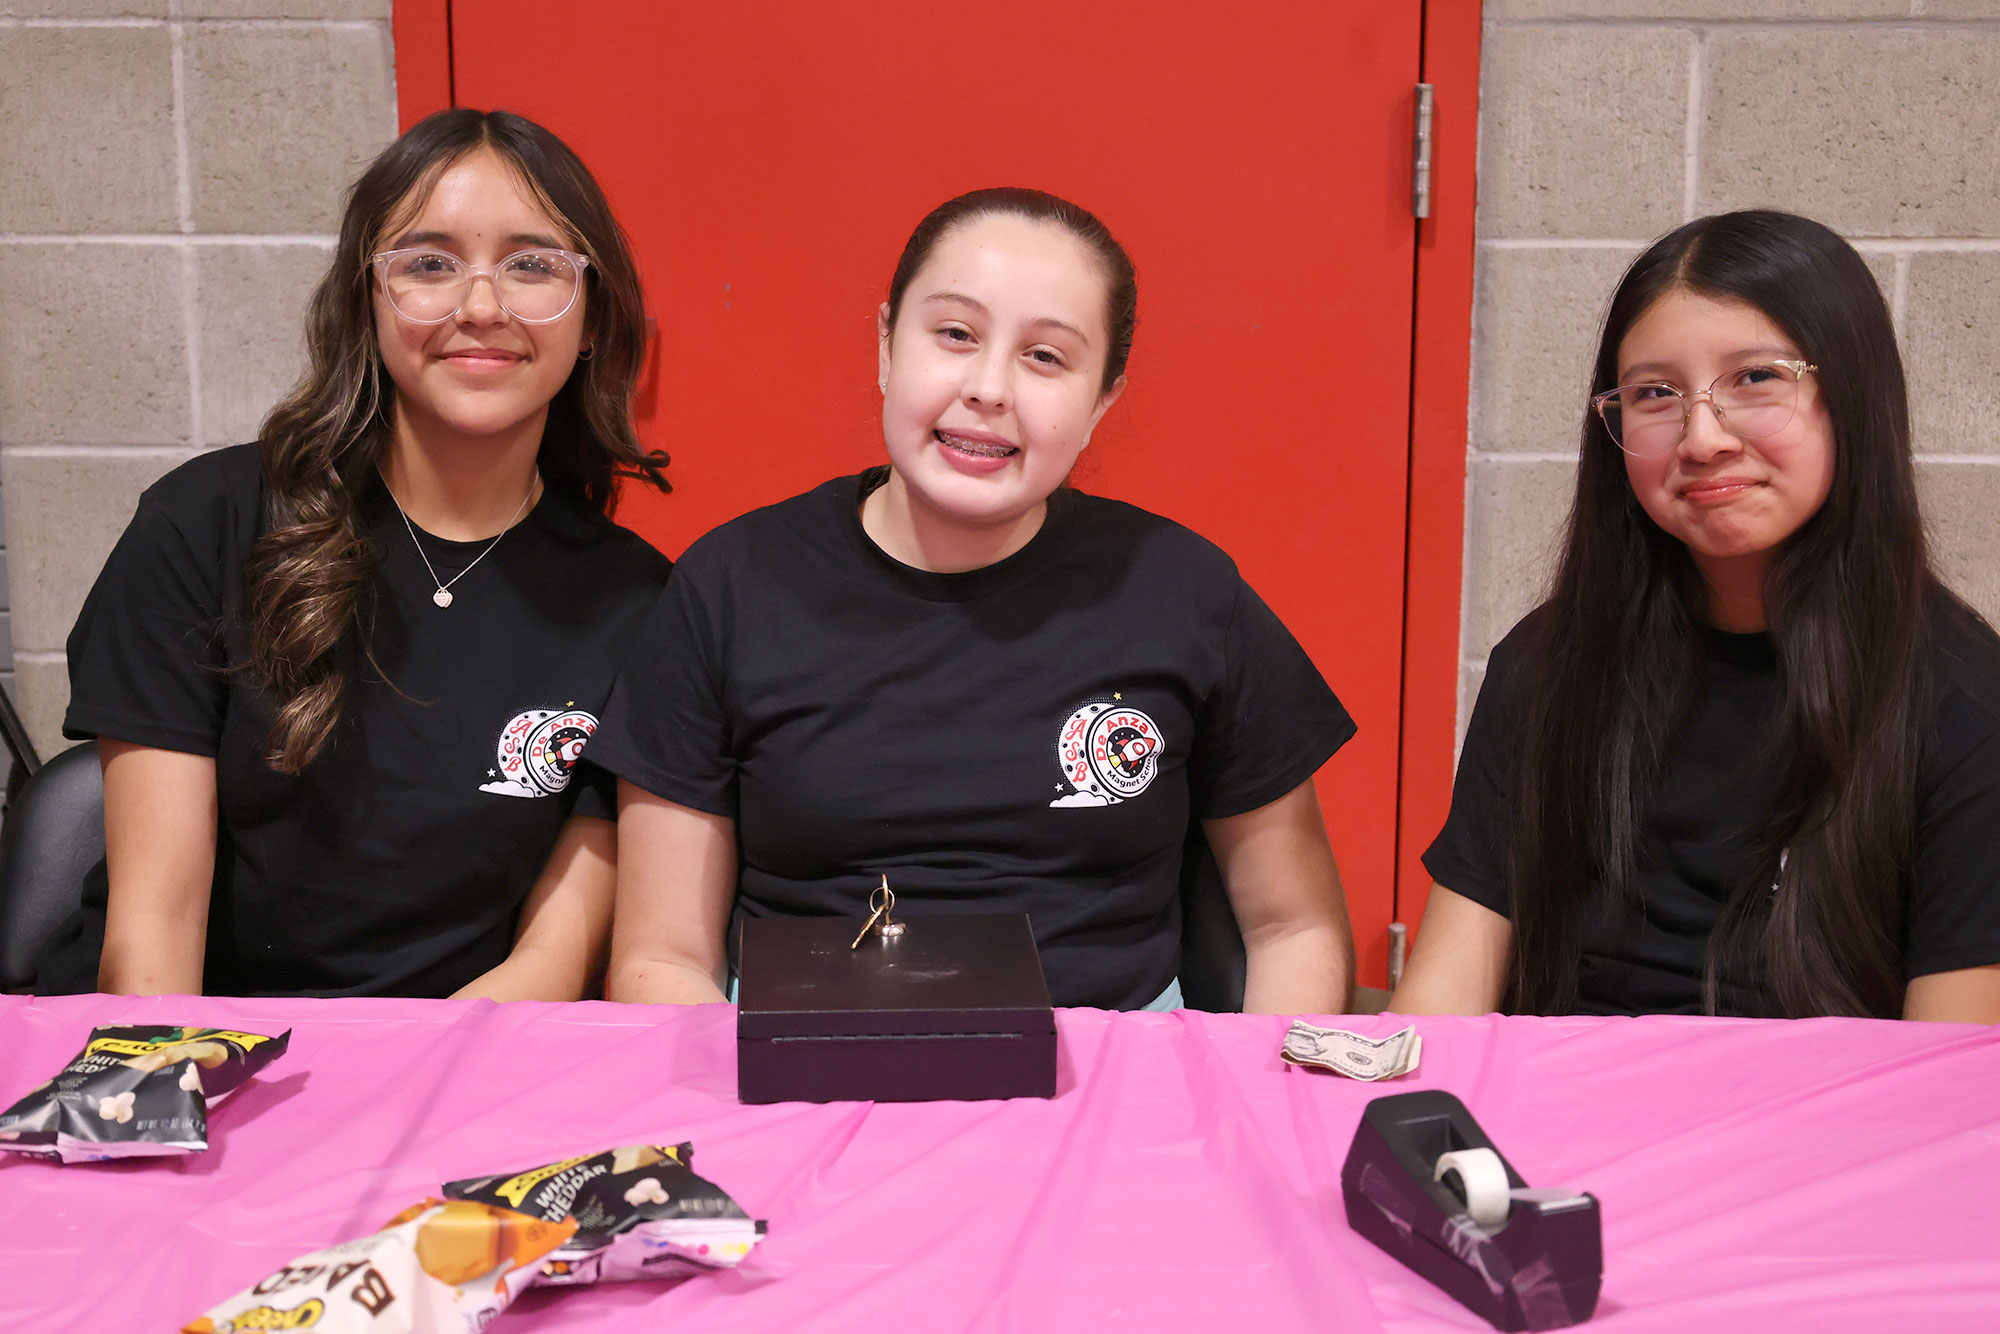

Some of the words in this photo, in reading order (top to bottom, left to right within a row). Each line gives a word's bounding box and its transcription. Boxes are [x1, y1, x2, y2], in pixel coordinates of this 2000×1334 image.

[532, 736, 548, 757] De
[551, 718, 596, 736] Anza
[1096, 734, 1107, 761] De
[1106, 716, 1149, 735] Anza
[1106, 769, 1140, 788] Magnet
